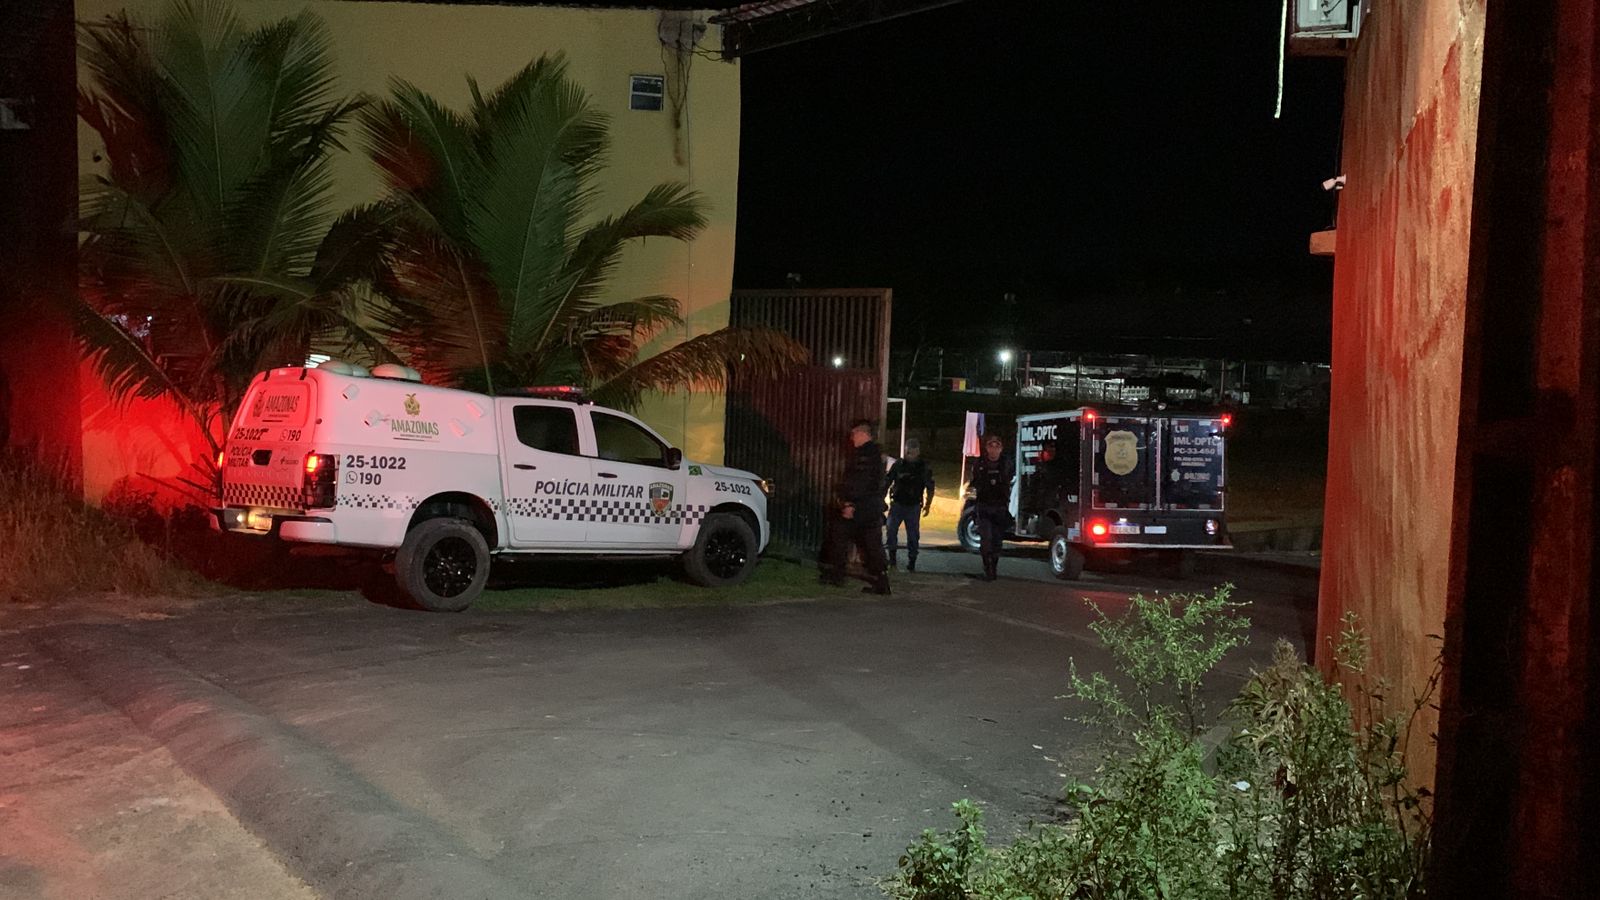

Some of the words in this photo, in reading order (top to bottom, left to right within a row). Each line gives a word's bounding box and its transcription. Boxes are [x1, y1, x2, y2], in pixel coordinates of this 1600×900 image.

[264, 395, 300, 413] AMAZONAS
[287, 429, 302, 442] 190
[391, 419, 440, 436] AMAZONAS
[1021, 425, 1058, 441] IML-DPTC
[1173, 436, 1219, 446] IML-DPTC
[346, 454, 407, 470] 25-1022
[359, 472, 382, 486] 190
[534, 478, 589, 496] POLÍCIA
[592, 483, 644, 499] MILITAR
[714, 481, 752, 496] 25-1022
